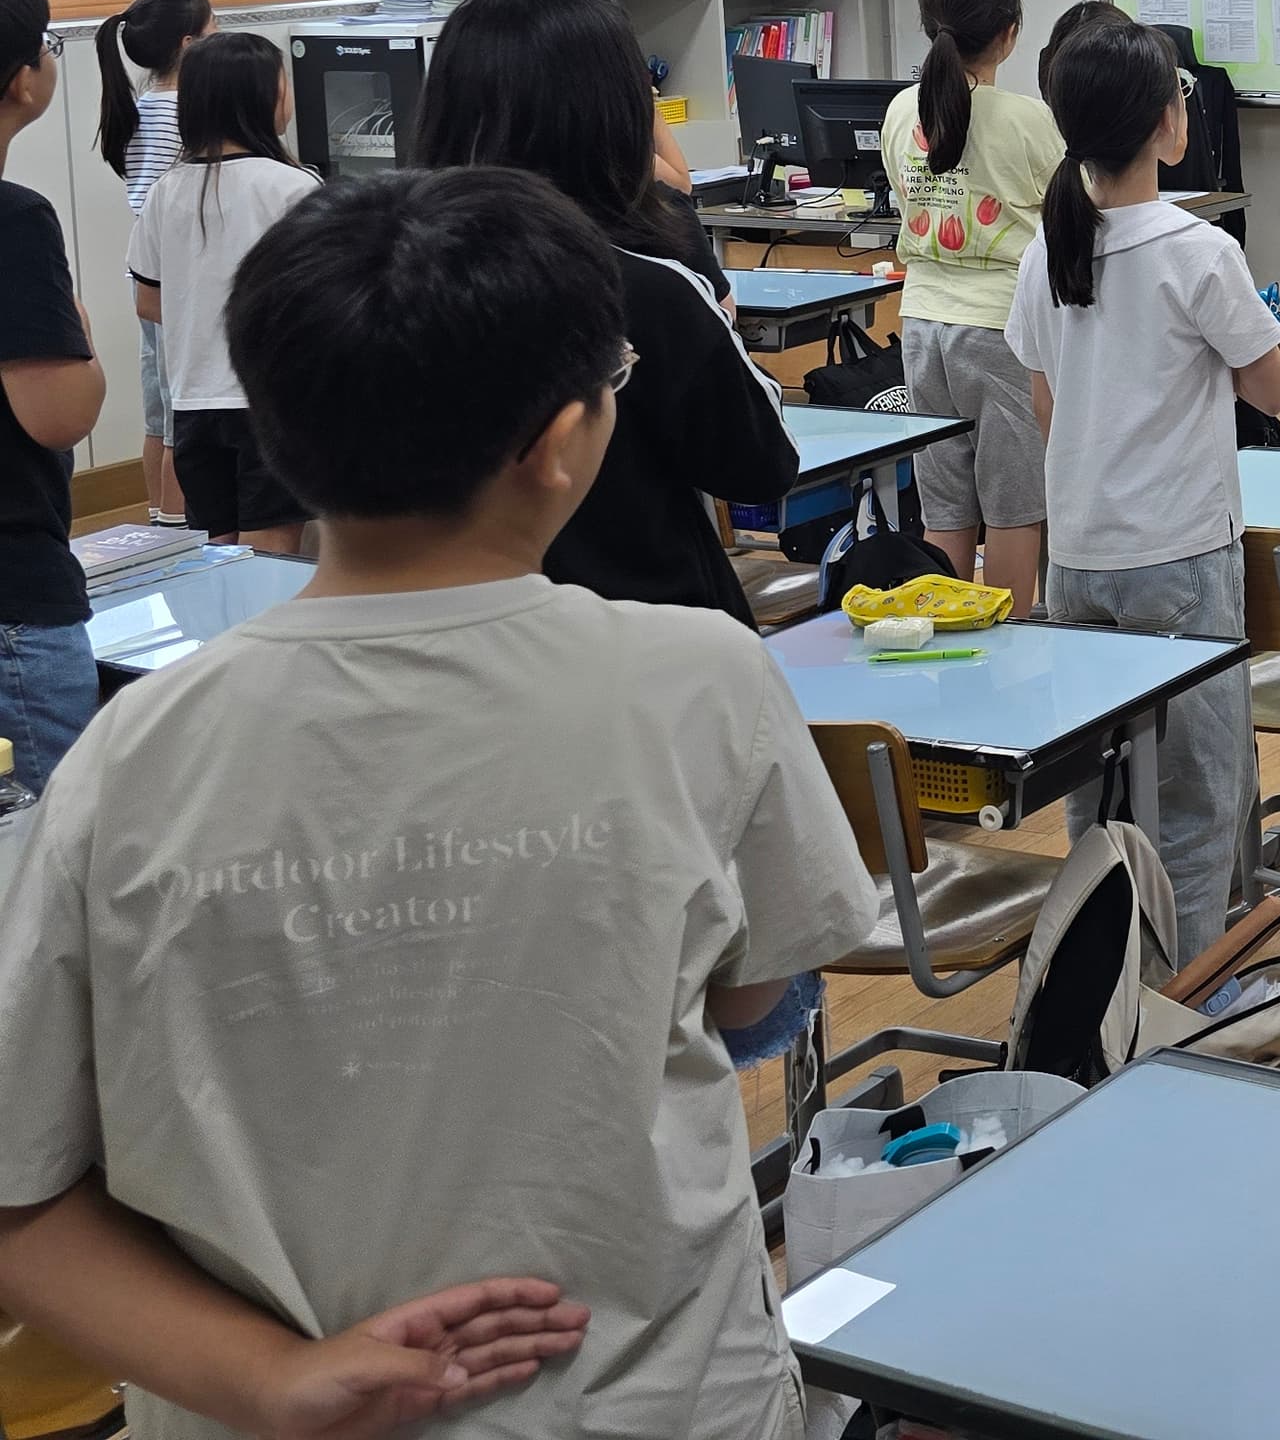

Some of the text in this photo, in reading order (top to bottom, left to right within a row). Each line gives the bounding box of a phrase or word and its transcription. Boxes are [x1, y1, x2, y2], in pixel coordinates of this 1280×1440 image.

[907, 186, 921, 194] AY
[155, 813, 612, 900] Outdoor Lifestyle
[283, 892, 481, 944] Creator
